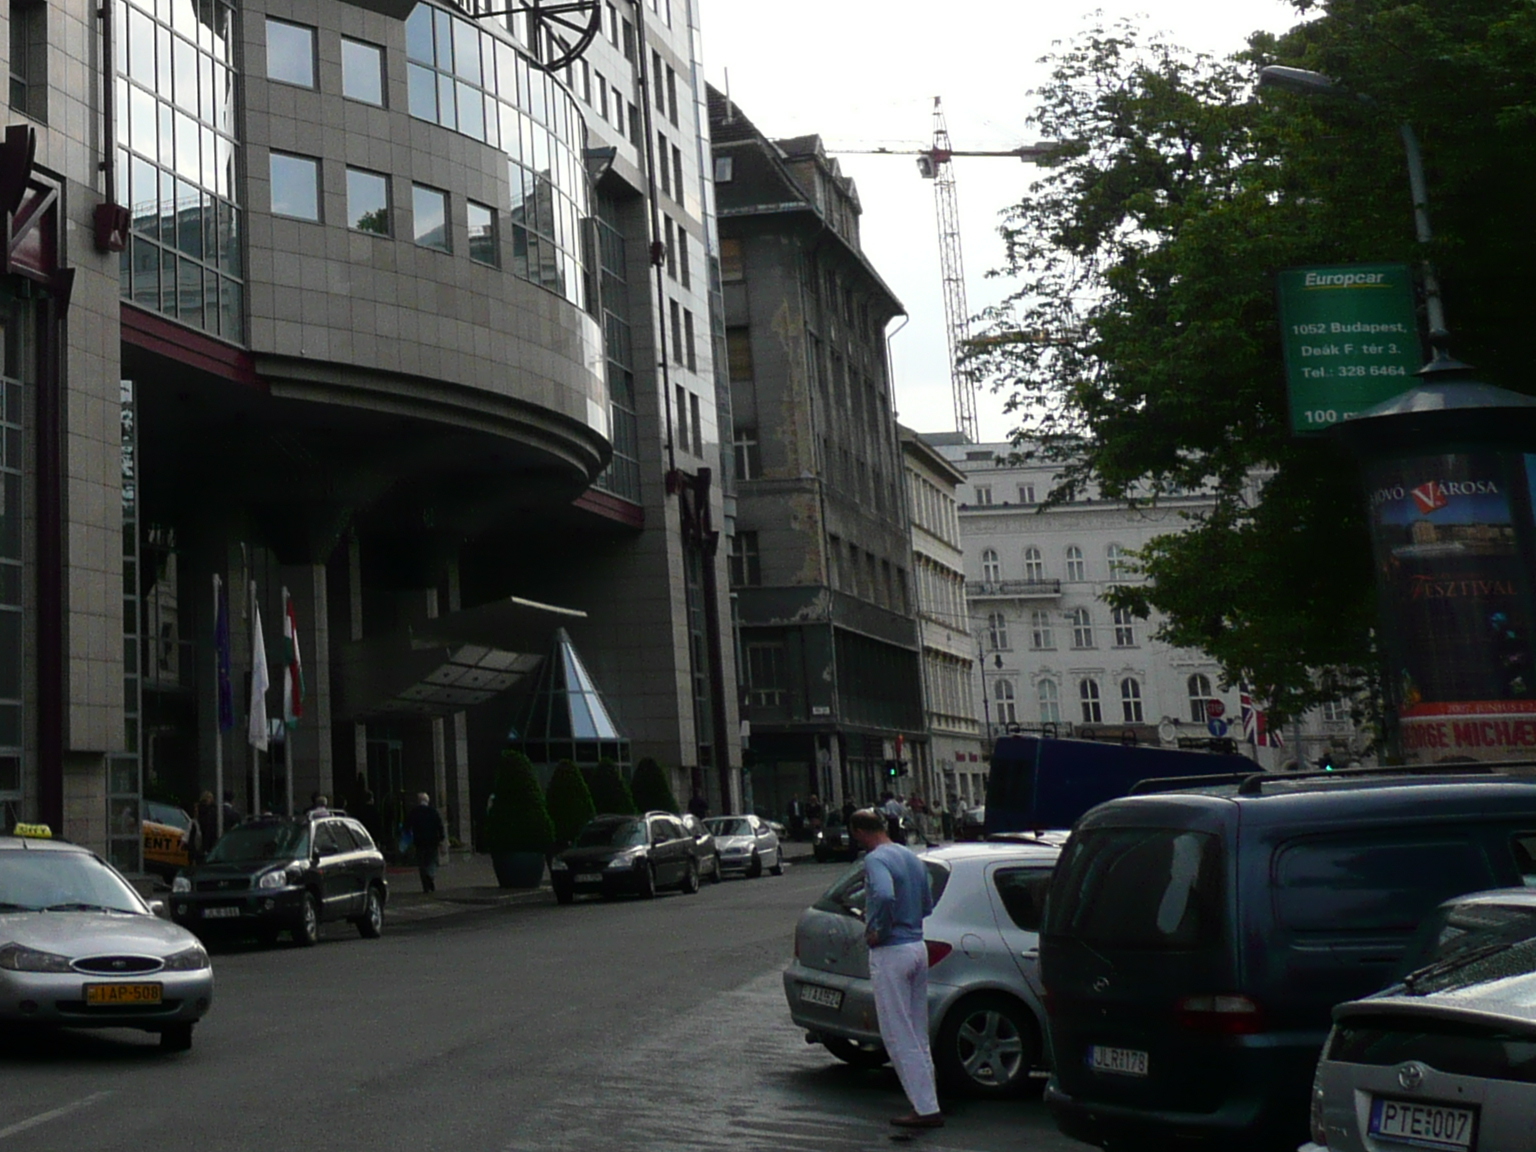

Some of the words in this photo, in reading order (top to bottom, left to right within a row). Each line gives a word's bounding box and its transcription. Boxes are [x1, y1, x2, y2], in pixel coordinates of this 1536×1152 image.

[1304, 272, 1385, 288] Europcar
[1292, 323, 1327, 335] 1052
[1330, 322, 1407, 334] Budapest,
[1300, 343, 1339, 356] Deák
[1361, 343, 1384, 354] tér
[1388, 344, 1402, 354] 3.
[1338, 366, 1365, 377] 328
[1369, 365, 1406, 376] 6464
[1304, 410, 1337, 423] 100
[143, 837, 172, 850] ENT
[101, 986, 158, 999] IAP-508
[1384, 1104, 1468, 1140] PTE-007
